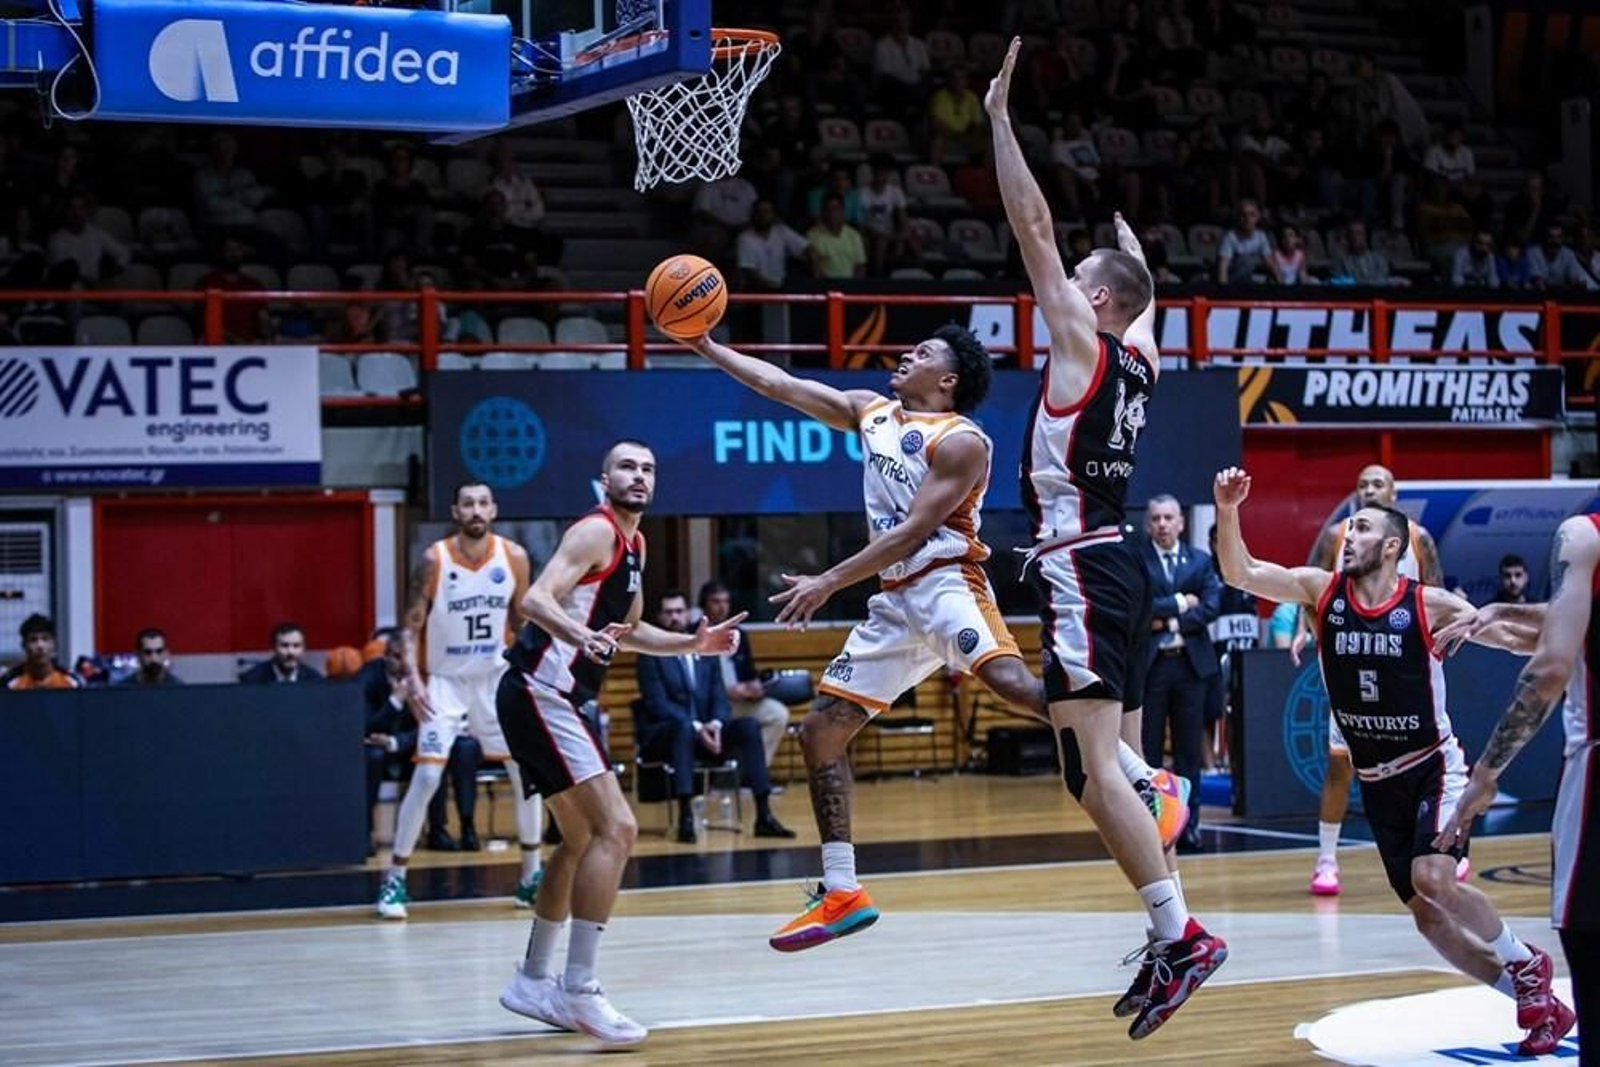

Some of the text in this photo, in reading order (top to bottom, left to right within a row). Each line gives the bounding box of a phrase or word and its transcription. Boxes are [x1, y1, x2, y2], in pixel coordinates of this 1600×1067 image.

[250, 26, 460, 86] affidea
[674, 274, 719, 310] Wilson
[1302, 369, 1531, 408] PROMITHEAS
[145, 420, 271, 444] engineering
[1450, 407, 1524, 423] PATRAS BC
[714, 420, 833, 464] FIND
[463, 613, 492, 641] 15
[1358, 669, 1380, 702] 5
